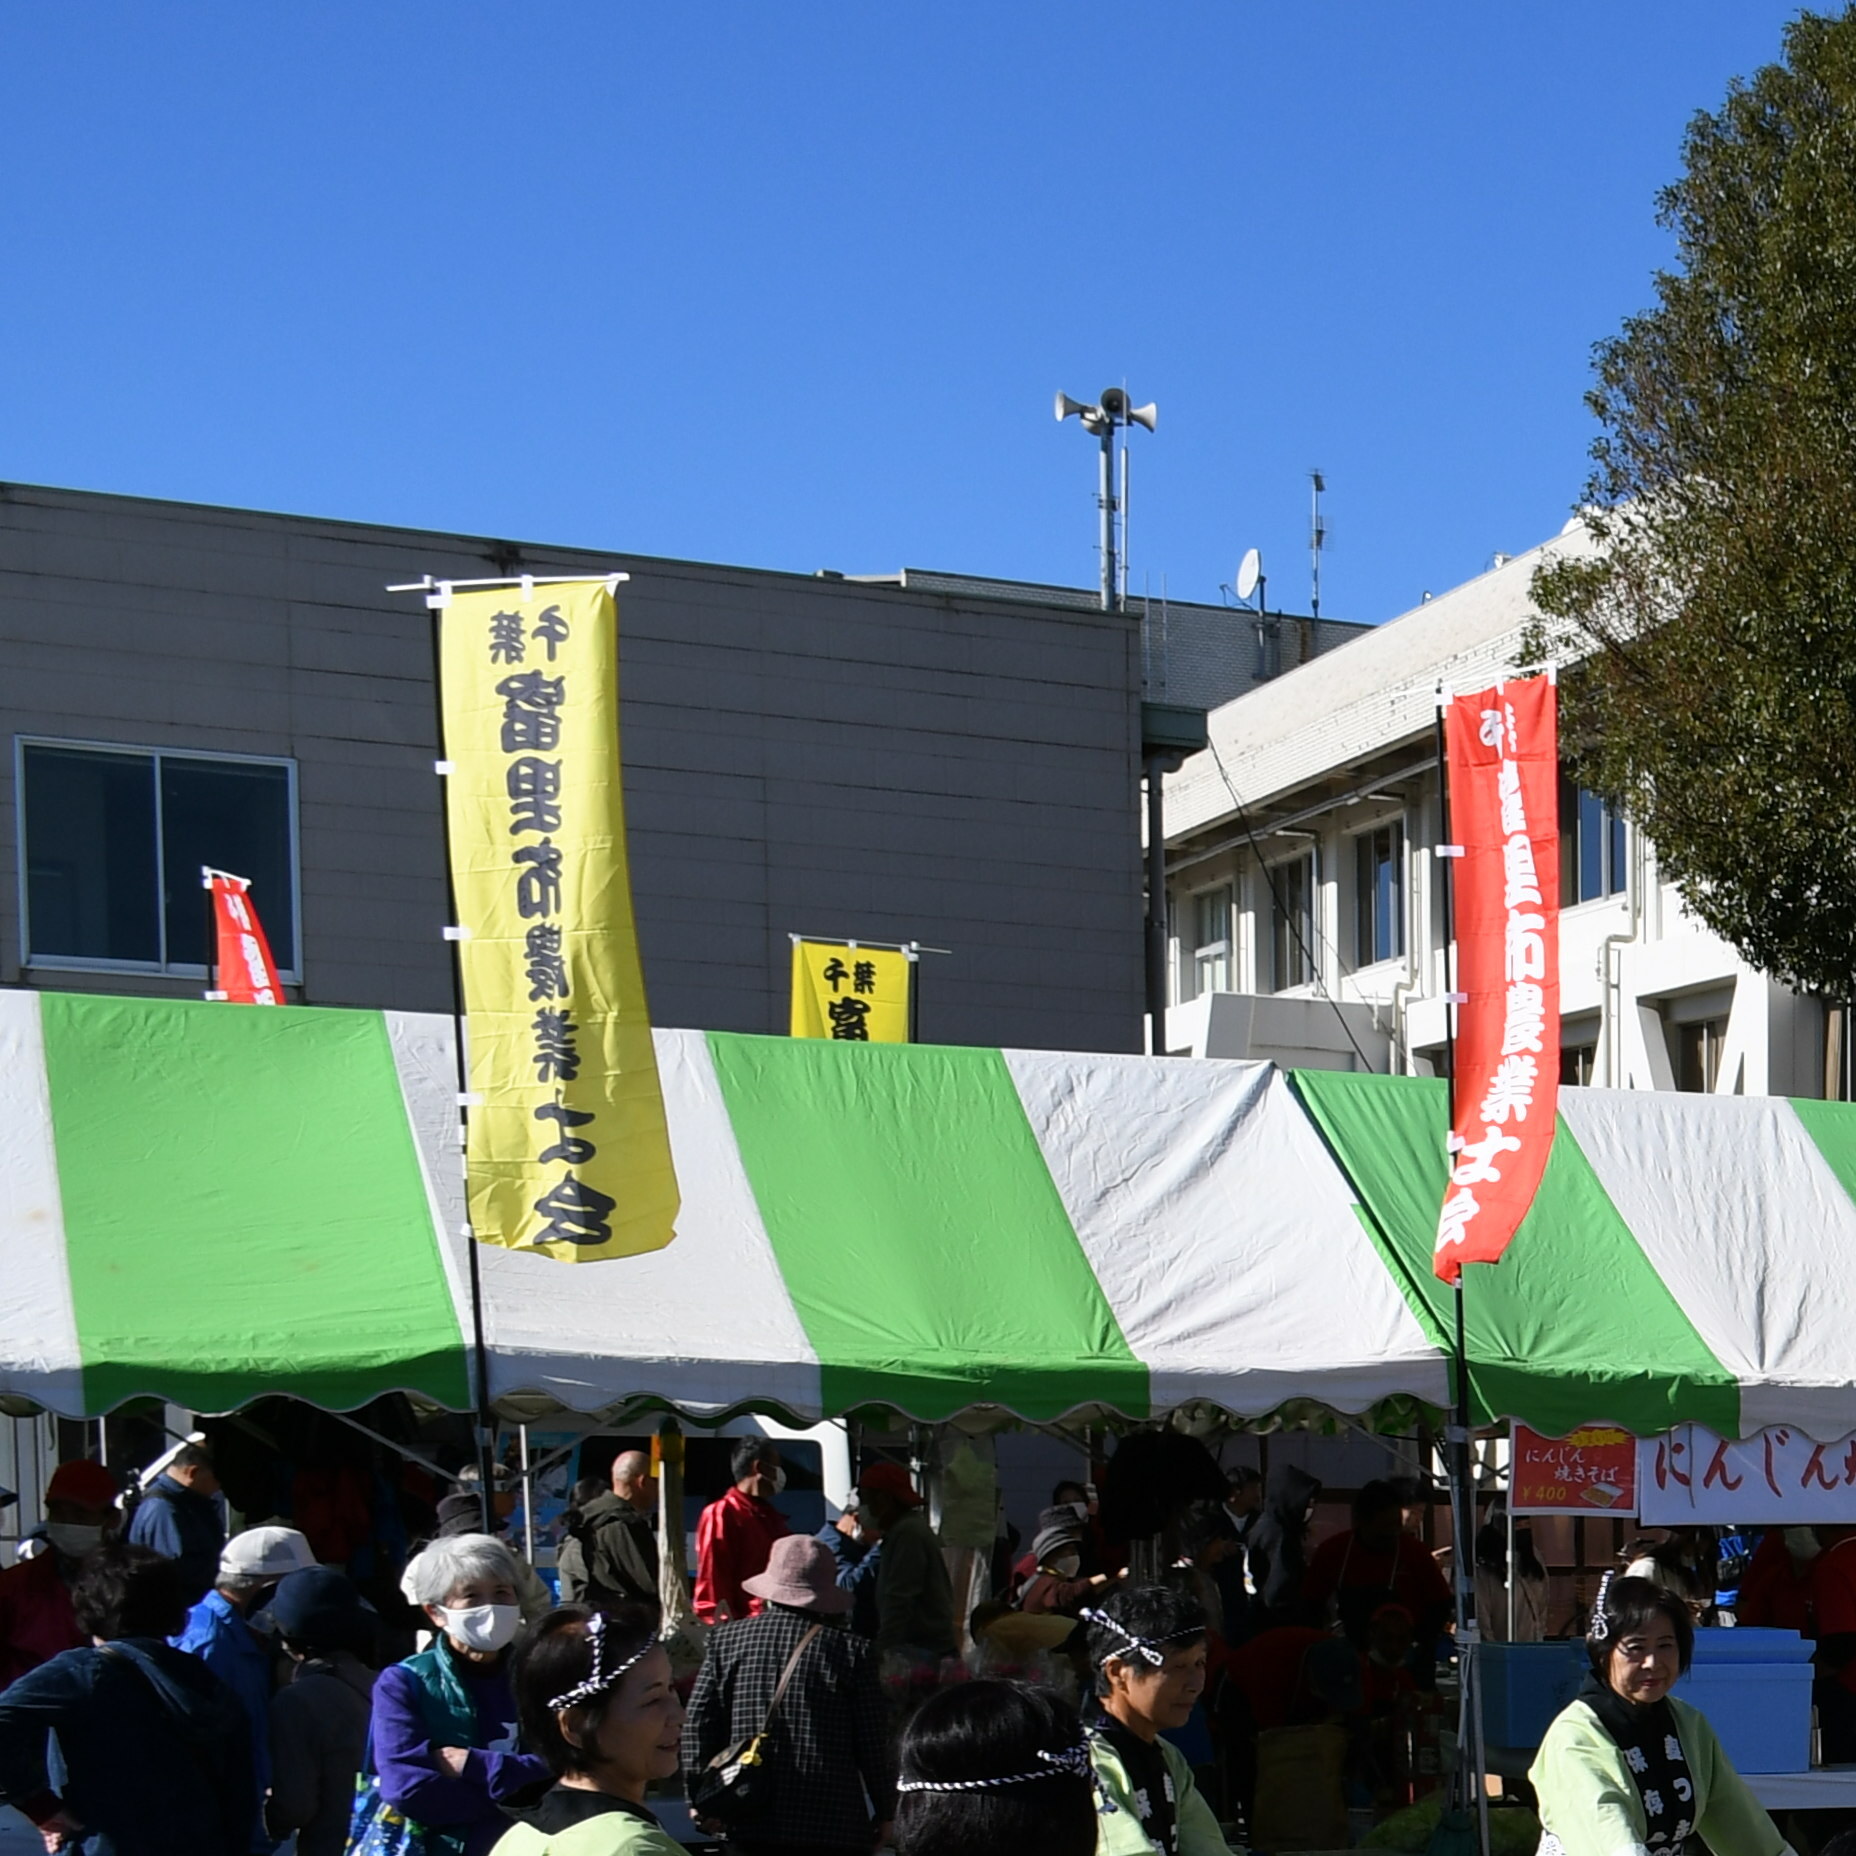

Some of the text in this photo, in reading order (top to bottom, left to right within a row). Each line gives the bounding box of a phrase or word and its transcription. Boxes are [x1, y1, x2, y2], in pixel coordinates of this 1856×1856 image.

[823, 957, 877, 995] 千葉
[1525, 1446, 1585, 1464] にんじん
[1554, 1466, 1620, 1483] 焼きそば
